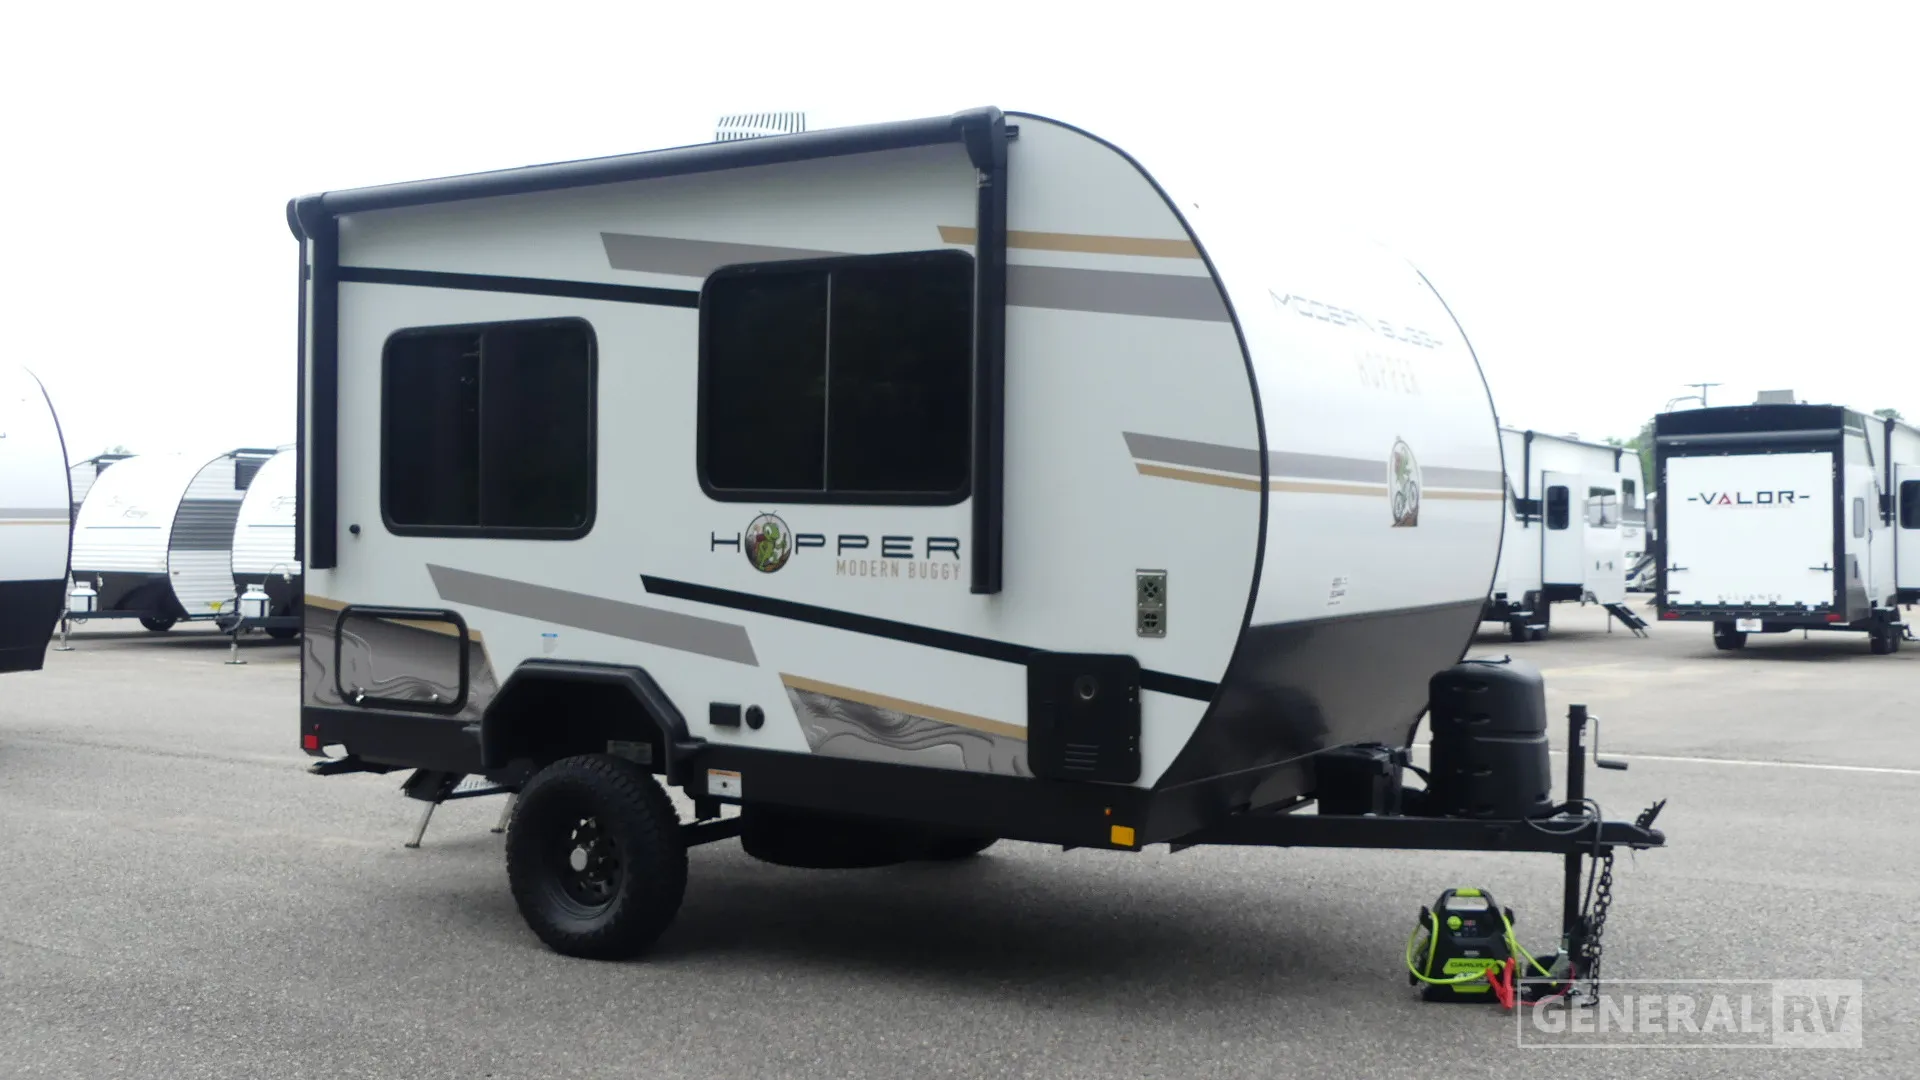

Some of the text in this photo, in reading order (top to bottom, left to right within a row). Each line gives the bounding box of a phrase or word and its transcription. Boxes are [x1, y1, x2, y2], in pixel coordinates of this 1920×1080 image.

[711, 512, 961, 573] HOPPER
[836, 559, 962, 581] MODERN BUGGY
